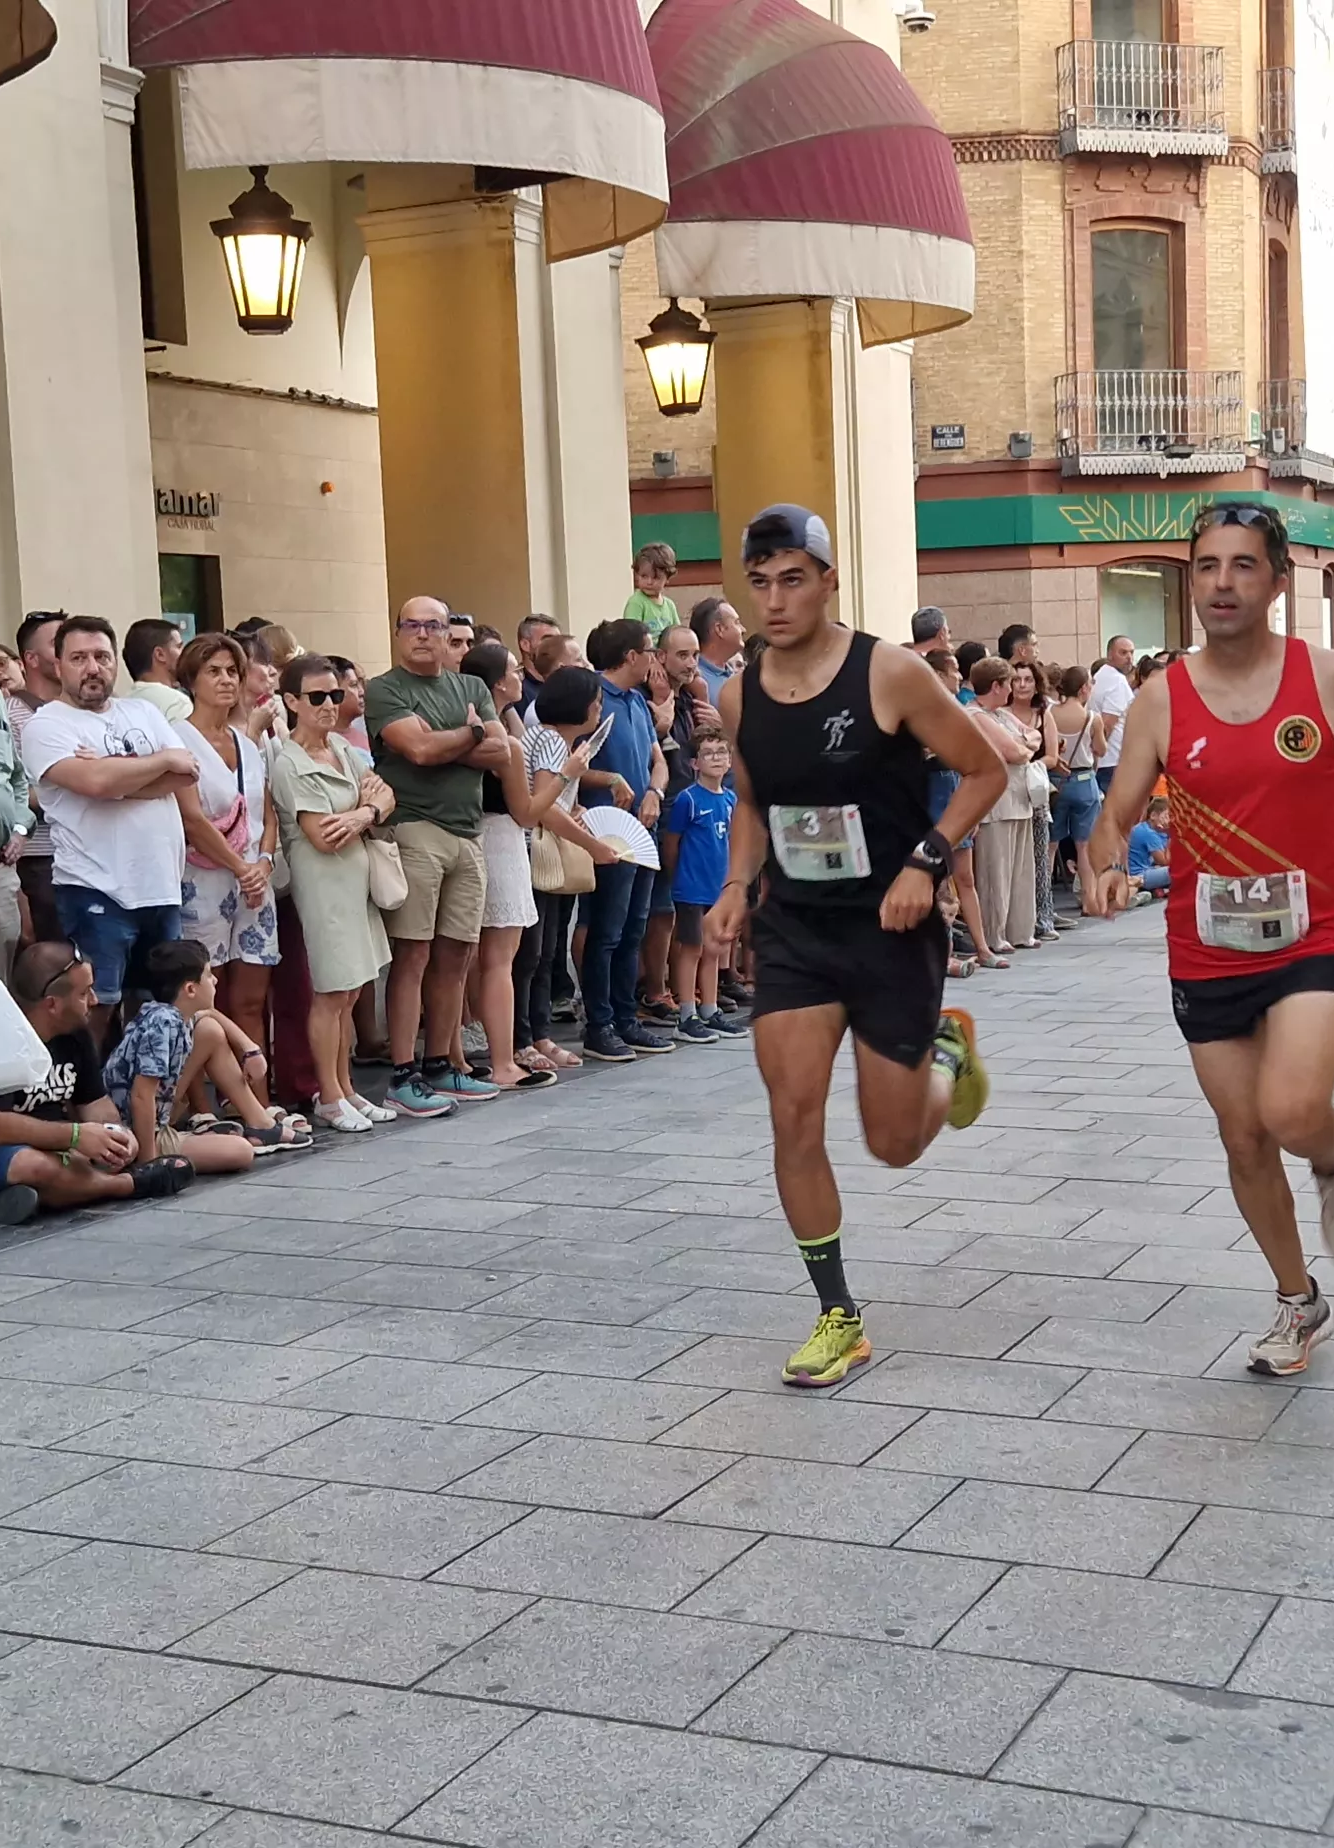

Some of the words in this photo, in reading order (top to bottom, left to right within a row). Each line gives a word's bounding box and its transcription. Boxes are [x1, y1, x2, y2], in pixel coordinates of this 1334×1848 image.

[936, 425, 960, 434] CALLE
[801, 810, 821, 837] 3
[1227, 877, 1271, 904] 14
